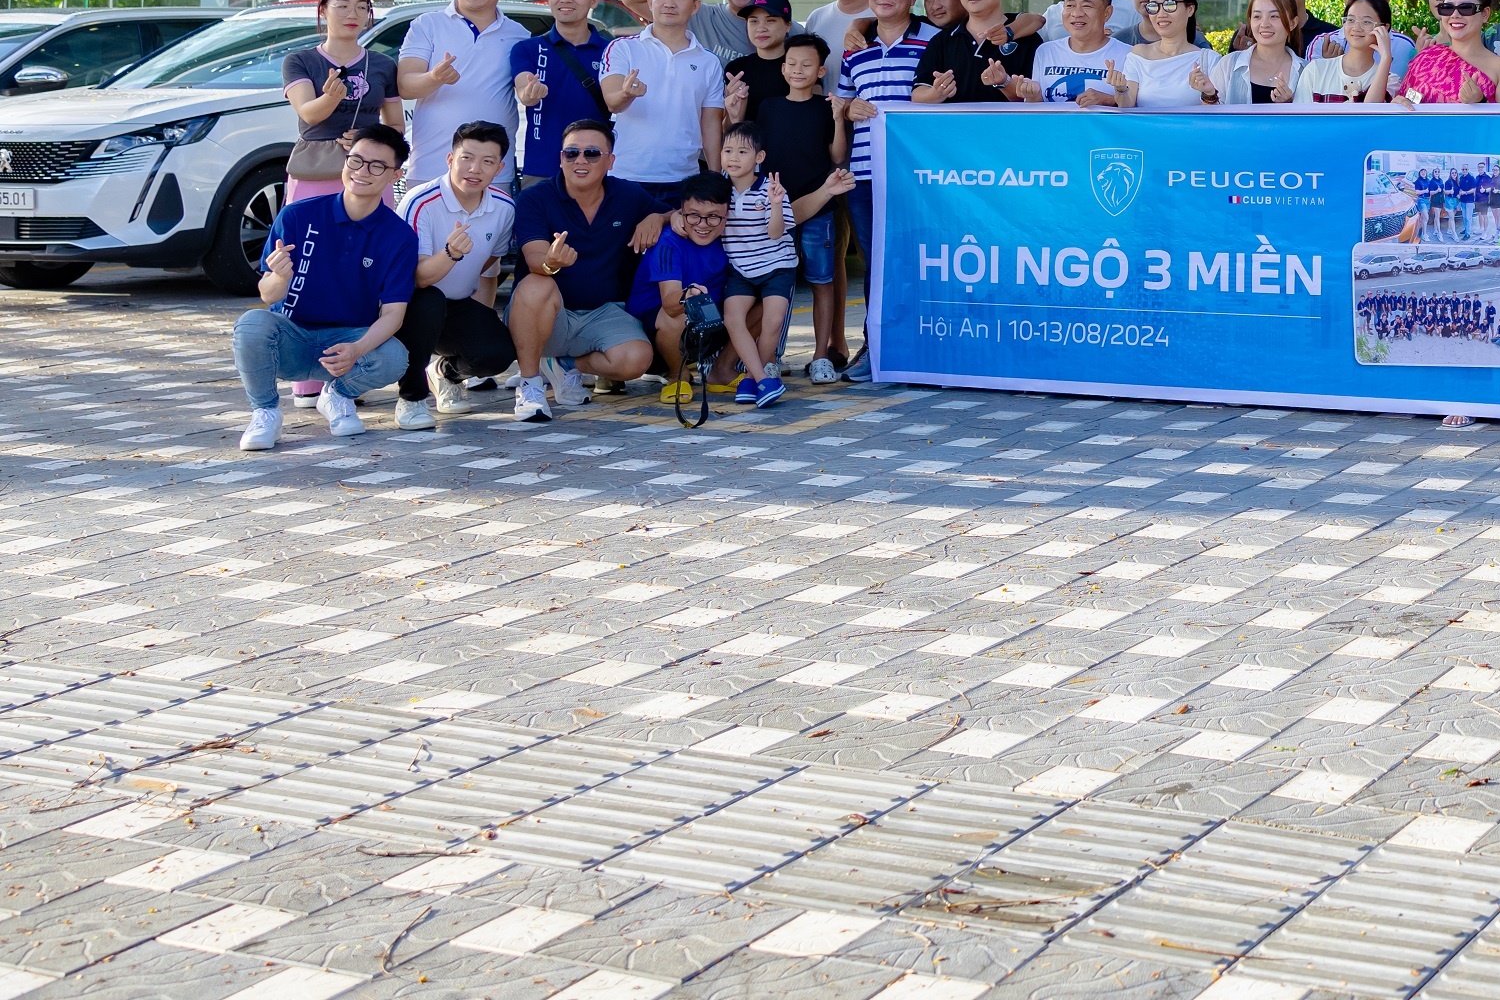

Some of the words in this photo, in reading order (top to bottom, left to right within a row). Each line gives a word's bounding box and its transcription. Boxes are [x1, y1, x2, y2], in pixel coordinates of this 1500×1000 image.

[1047, 67, 1109, 79] AUTHENTI
[533, 43, 549, 140] PEUEOT
[914, 169, 995, 186] THACO
[998, 168, 1068, 187] AUTO
[1168, 170, 1325, 190] PEUGEOT
[1242, 195, 1272, 205] CLUB
[1274, 196, 1325, 206] VIETNAM
[281, 223, 319, 319] EUGEOT
[919, 234, 999, 293] HỘI
[1016, 237, 1129, 299] NGỘ
[1144, 249, 1171, 291] 3
[1188, 234, 1322, 296] MIỀN
[919, 315, 952, 341] Hội
[959, 317, 989, 339] An
[1008, 319, 1169, 348] 10-13/08/2024
